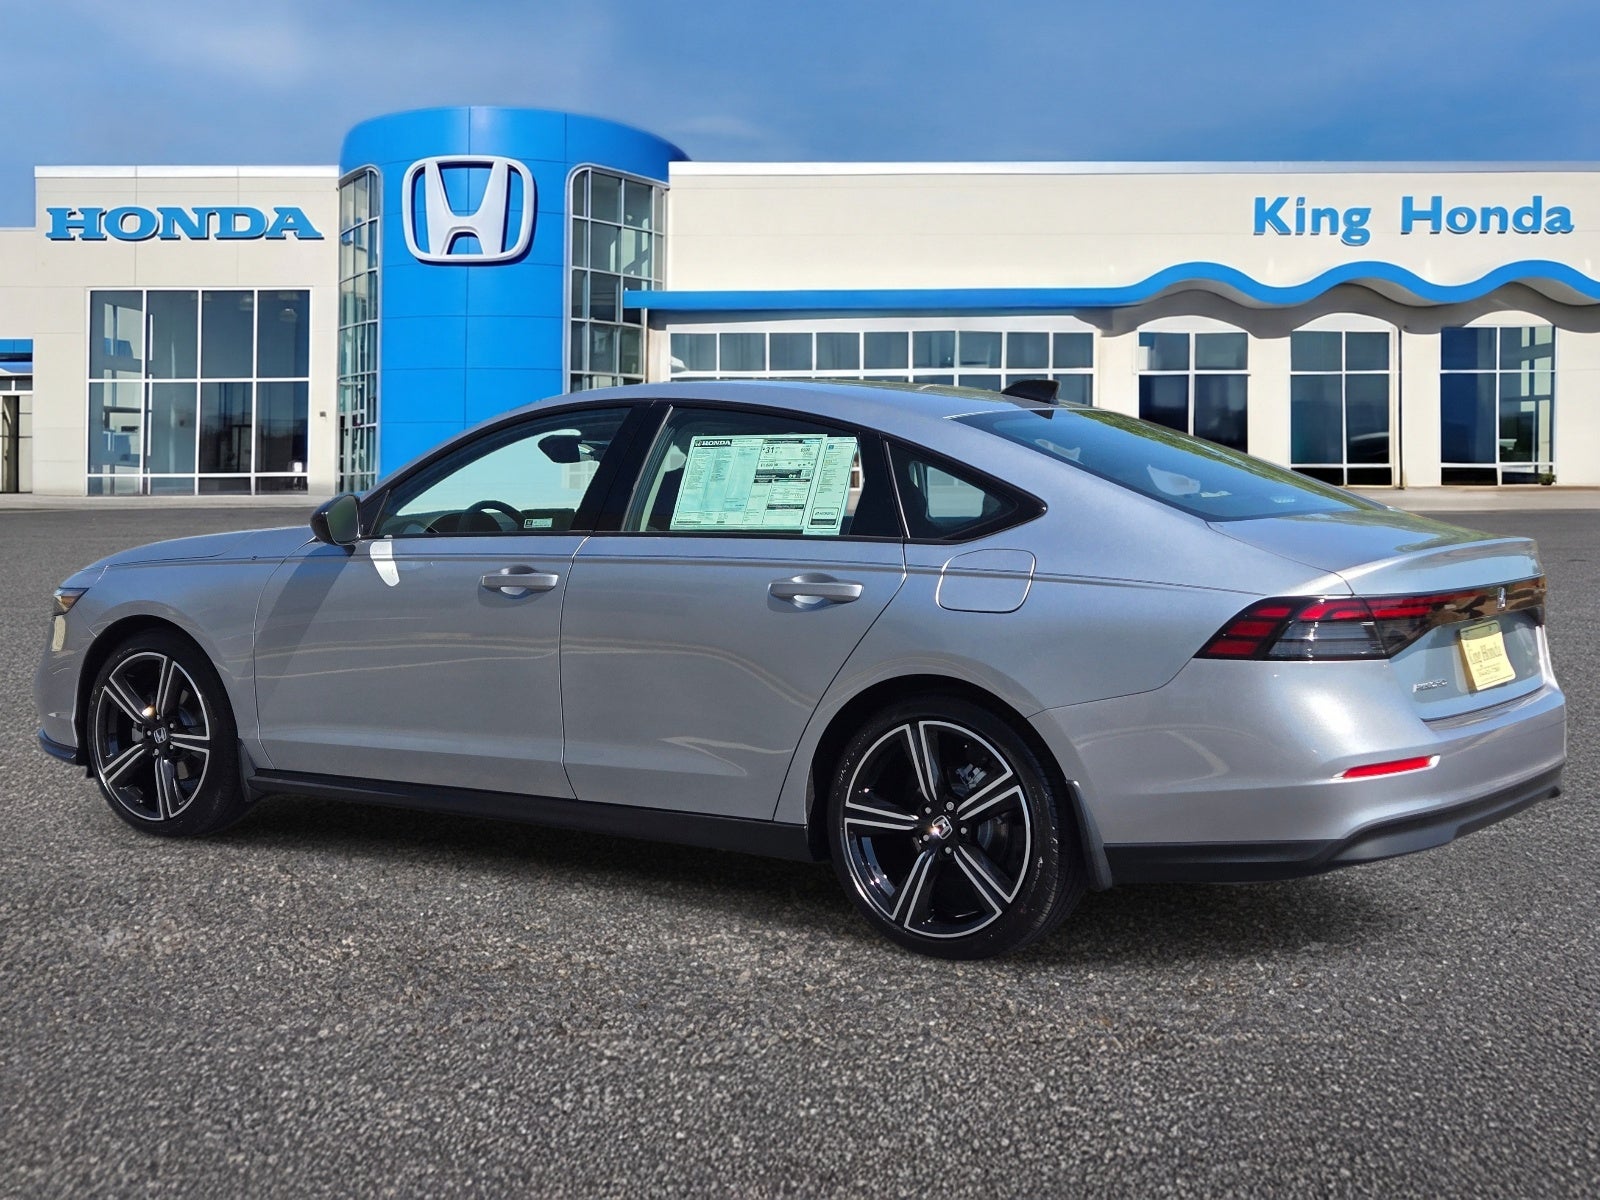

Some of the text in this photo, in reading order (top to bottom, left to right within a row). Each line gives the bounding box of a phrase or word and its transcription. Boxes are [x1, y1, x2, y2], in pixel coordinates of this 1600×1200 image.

[46, 206, 324, 242] HONDA
[1253, 195, 1575, 247] King Honda
